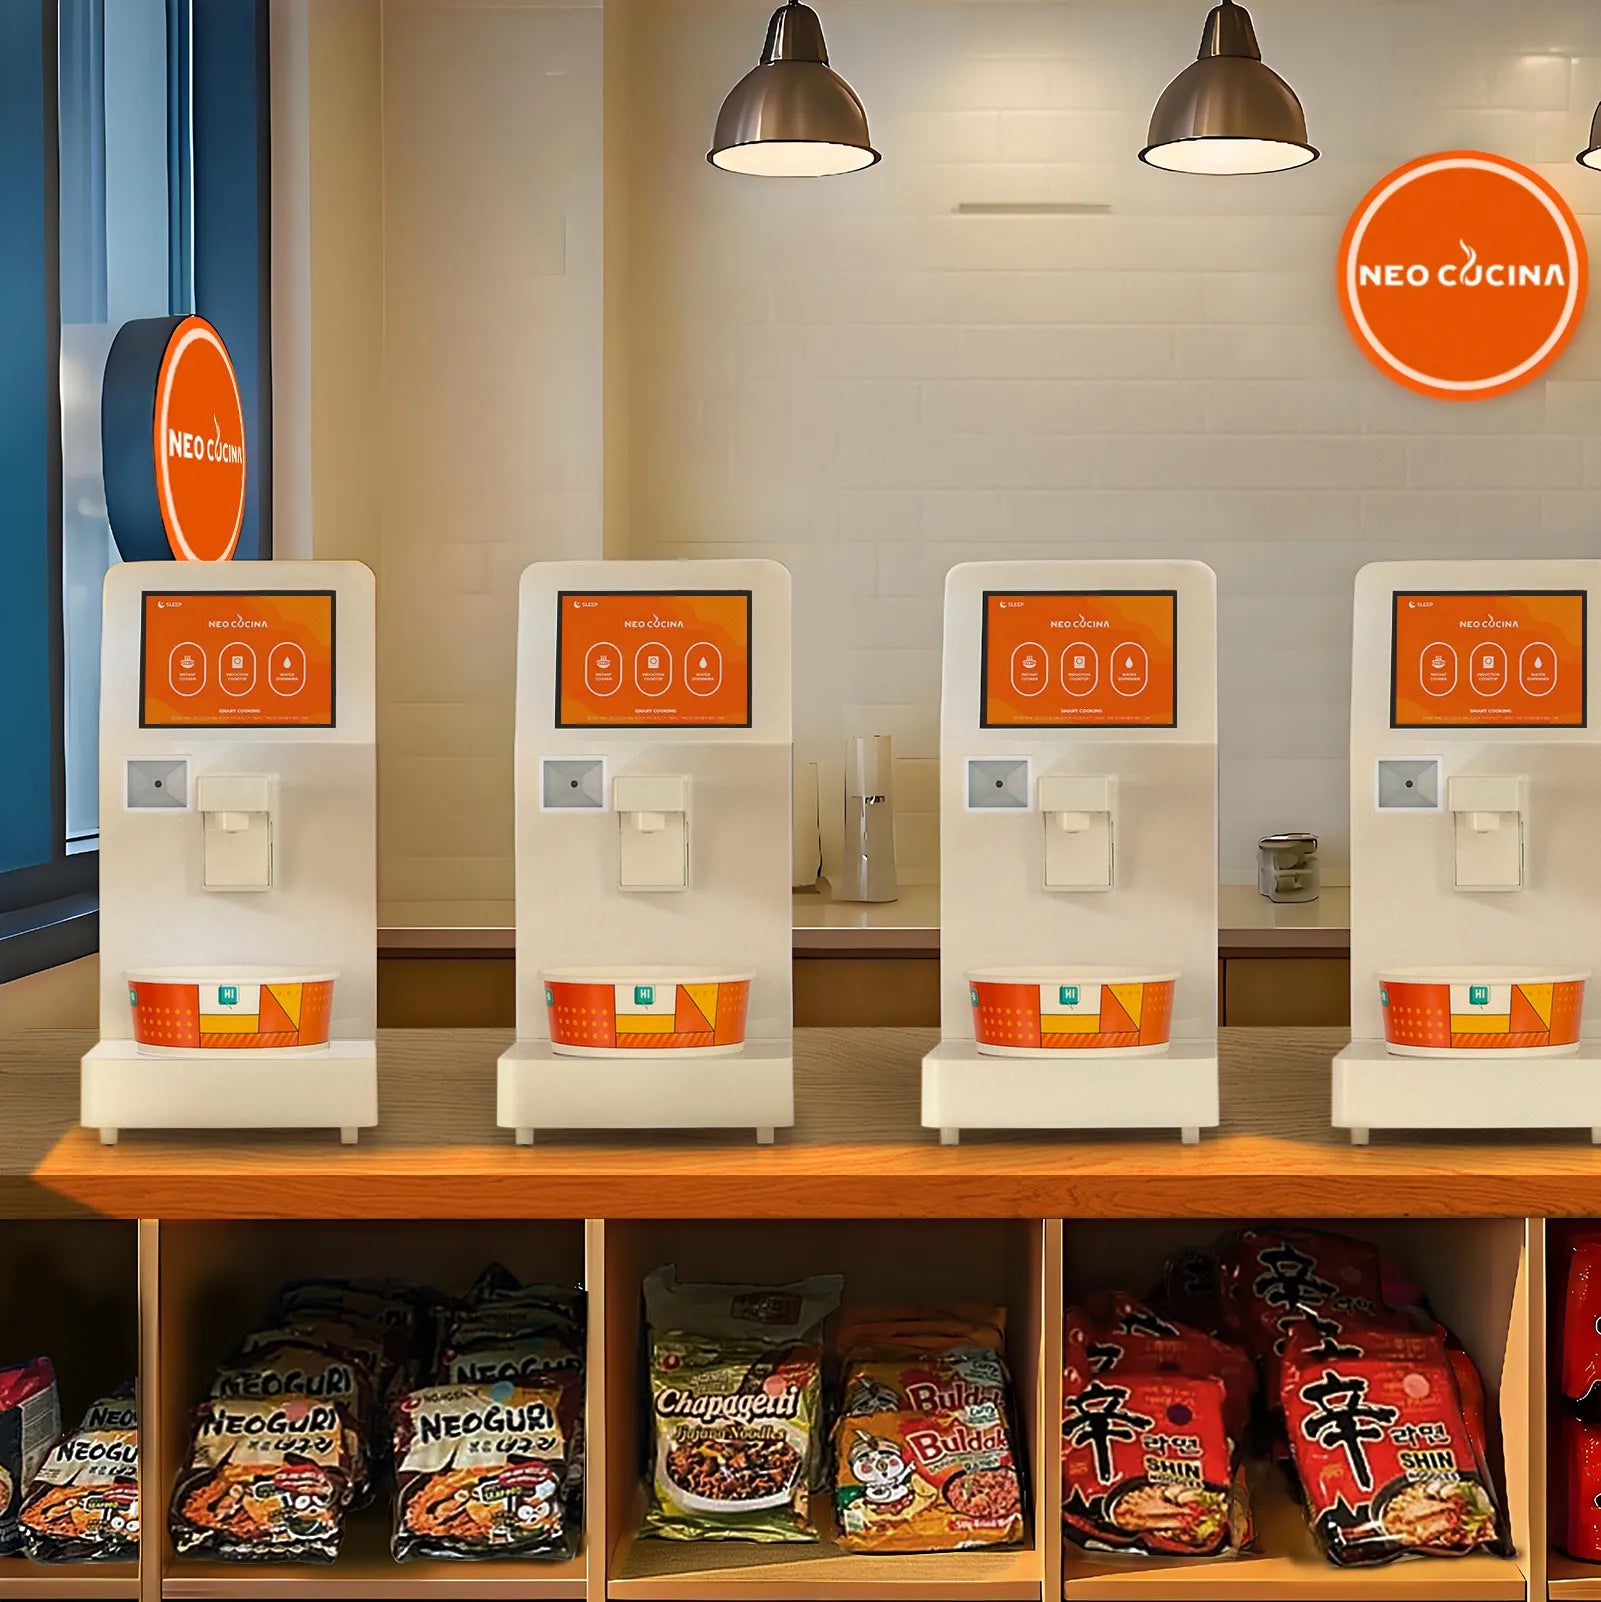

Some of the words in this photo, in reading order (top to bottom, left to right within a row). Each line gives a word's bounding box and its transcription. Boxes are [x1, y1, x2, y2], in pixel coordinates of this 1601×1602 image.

[1359, 264, 1429, 286] NEO
[1437, 238, 1565, 286] CUCINA
[168, 428, 204, 460] NEO
[207, 413, 243, 464] CUCINA
[208, 620, 229, 628] NEO
[231, 614, 268, 628] CUCINA
[624, 620, 645, 628] NEO
[647, 614, 684, 628] CUCINA
[1050, 620, 1071, 628] NEO
[1073, 614, 1110, 628] CUCINA
[1459, 620, 1480, 628] NEO
[1482, 614, 1519, 628] CUCINA
[224, 988, 234, 999] HI
[640, 988, 650, 999] HI
[1065, 988, 1075, 999] HI
[1475, 988, 1485, 999] HI
[656, 1385, 799, 1425] Chapagetti
[89, 1407, 137, 1427] NEO
[201, 1407, 336, 1436] NEOGURI
[420, 1402, 555, 1444] NEOGURI
[1062, 1380, 1154, 1484] 辛
[1300, 1369, 1399, 1491] 辛
[1390, 1423, 1451, 1448] 라면
[906, 1426, 1009, 1465] Buldak
[1144, 1455, 1202, 1480] SHIN
[1399, 1451, 1456, 1470] SHIN
